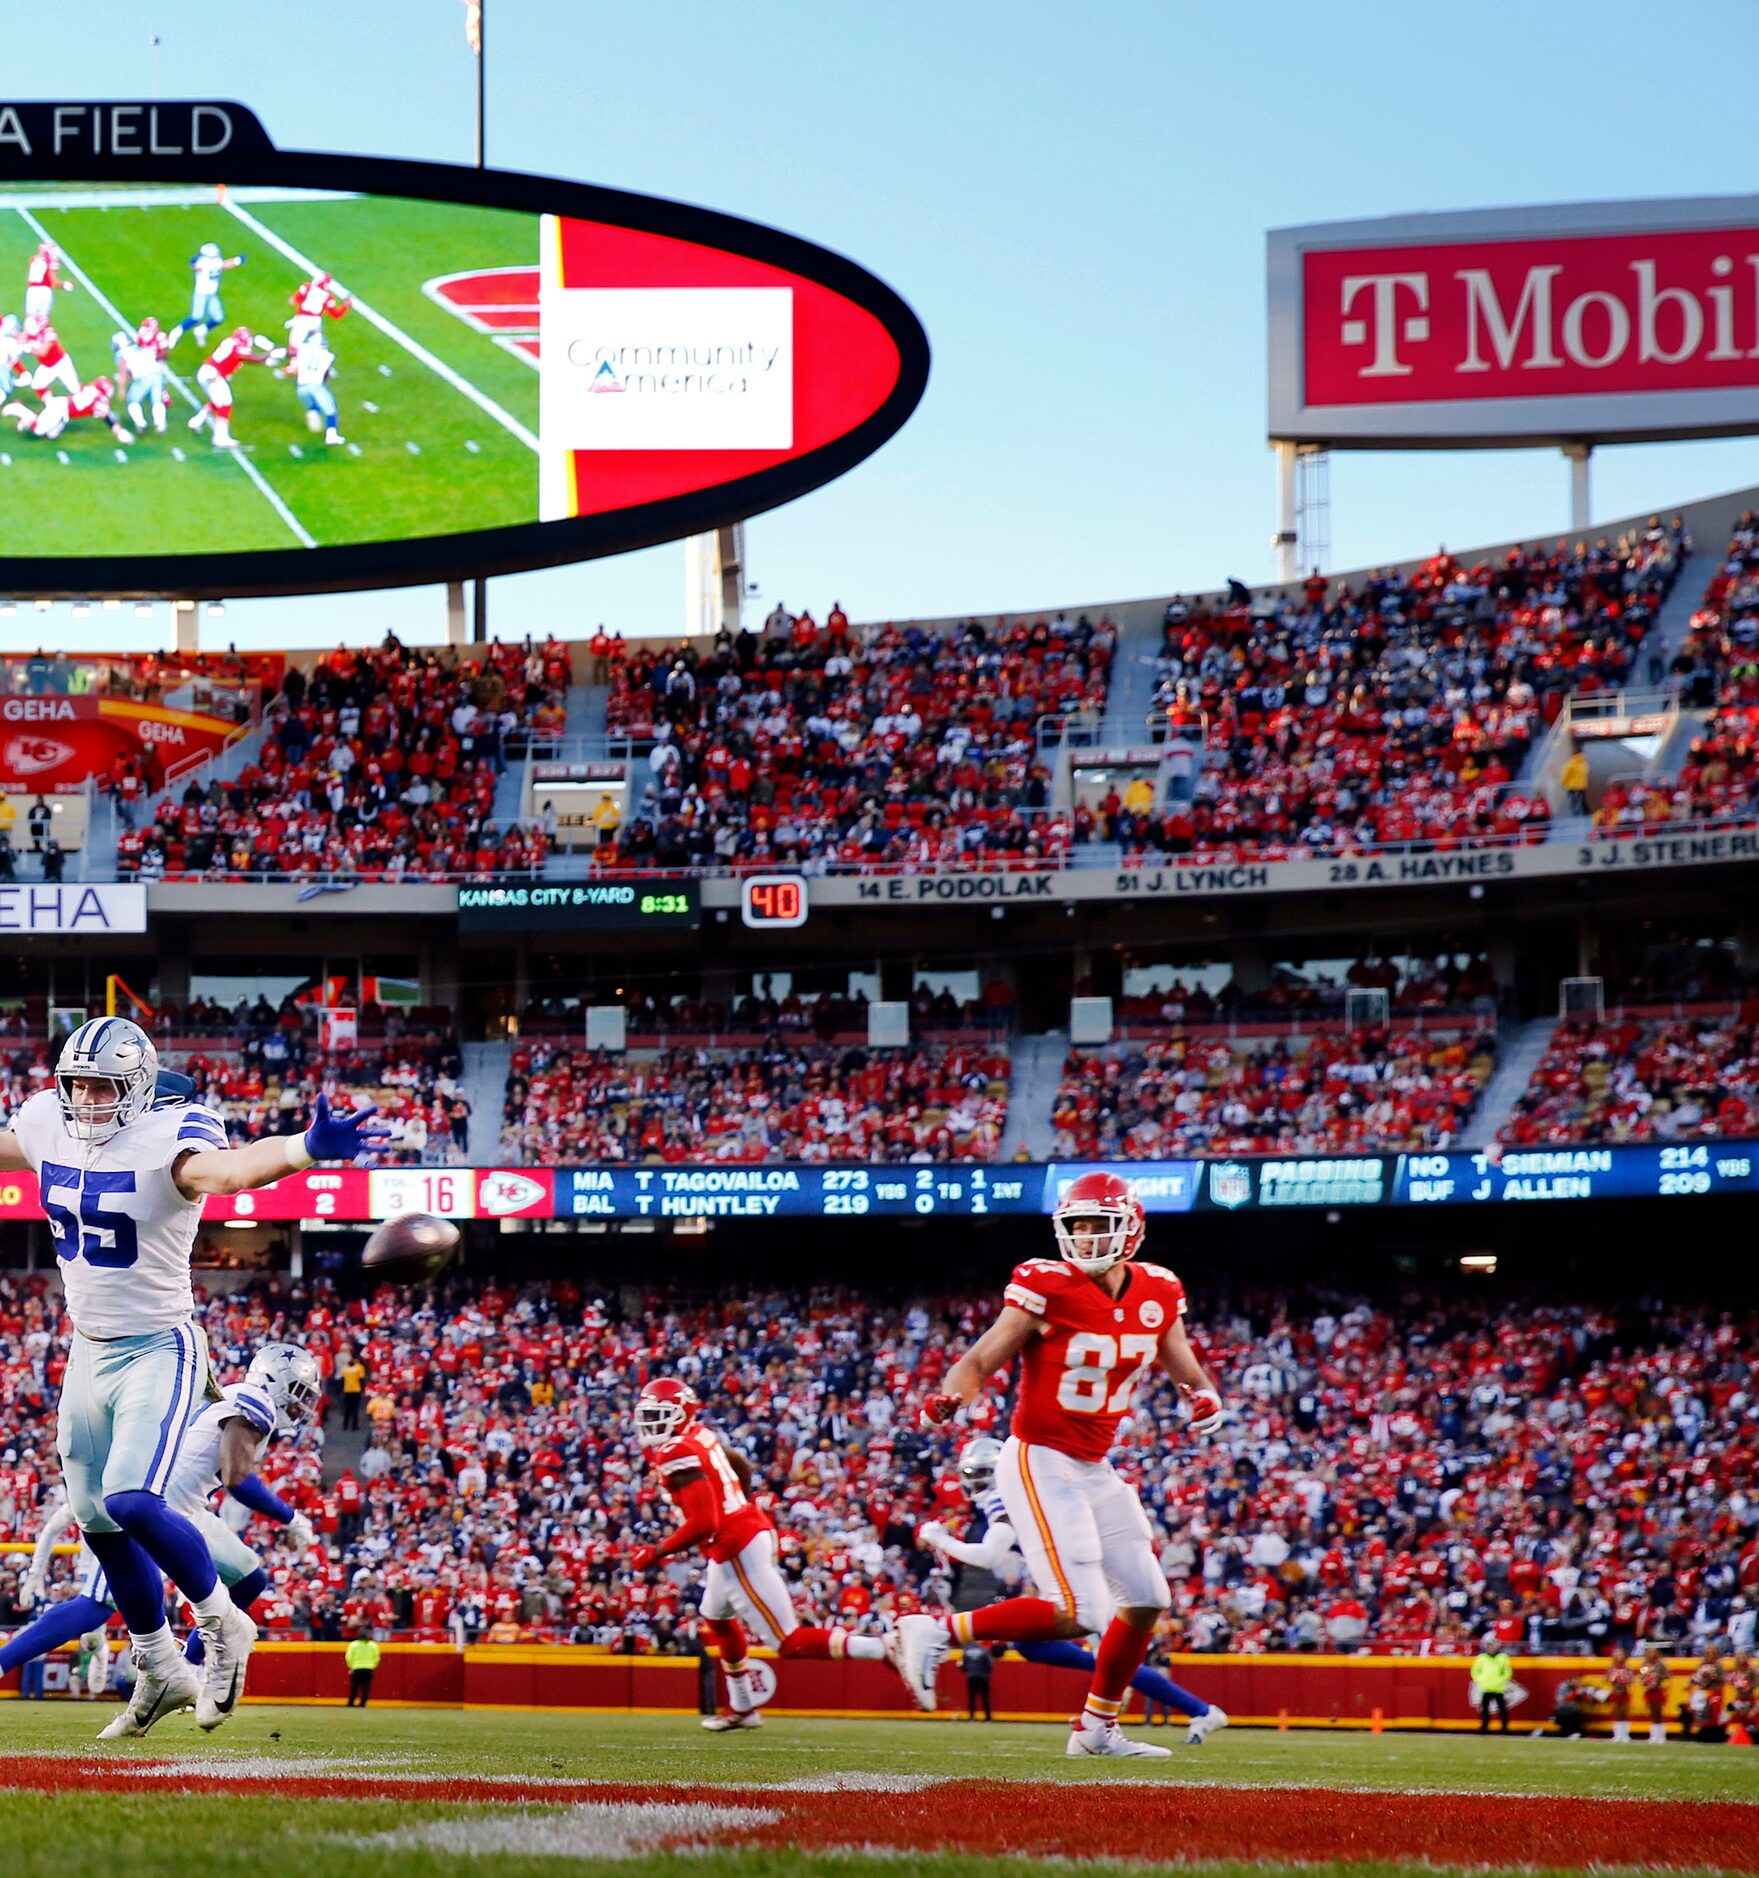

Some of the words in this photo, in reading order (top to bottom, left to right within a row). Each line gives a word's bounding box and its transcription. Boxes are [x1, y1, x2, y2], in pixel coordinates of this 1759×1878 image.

[54, 107, 232, 155] FIELD
[567, 339, 779, 372] Community
[3, 700, 76, 720] GEHA
[140, 720, 185, 745] GEHA
[1329, 864, 1358, 883] 28
[1366, 861, 1391, 881] A.
[1400, 851, 1515, 880] HAYNES
[1577, 848, 1593, 867] 3
[1601, 842, 1625, 866] J.
[859, 882, 880, 899] 14
[888, 880, 911, 899] E.
[919, 874, 1052, 898] PODOLAK
[1116, 875, 1137, 893] 51
[1147, 871, 1168, 892] J.
[1177, 866, 1267, 891] LYNCH
[459, 887, 529, 907] KANSAS
[531, 887, 570, 906] CITY
[572, 886, 635, 905] 8-YARD
[641, 895, 688, 914] 8:31
[751, 883, 799, 919] 40
[1260, 1159, 1383, 1183] PASSING
[1409, 1156, 1449, 1177] NO
[1471, 1154, 1488, 1174] T
[1659, 1146, 1709, 1169] 214
[306, 1175, 342, 1189] QTR
[573, 1171, 614, 1191] MIA
[634, 1171, 654, 1191] T
[661, 1171, 800, 1192] TAGOVAILOA
[822, 1170, 869, 1190] 273
[915, 1169, 934, 1190] 2
[971, 1168, 988, 1189] 1
[937, 1183, 962, 1200] TD
[992, 1182, 1023, 1199] INT
[1409, 1180, 1453, 1201] BUF
[1471, 1179, 1491, 1200] J
[1503, 1177, 1590, 1200] ALLEN
[1659, 1172, 1711, 1195] 209
[234, 1193, 254, 1215] 8
[315, 1193, 335, 1215] 2
[389, 1194, 403, 1209] 3
[423, 1177, 454, 1213] 16
[573, 1195, 615, 1214] BAL
[634, 1195, 654, 1214] T
[661, 1195, 780, 1216] HUNTLEY
[823, 1194, 869, 1214] 219
[915, 1193, 935, 1214] 0
[971, 1193, 988, 1214] 1
[40, 1160, 138, 1268] 55
[1057, 1333, 1158, 1412] 87
